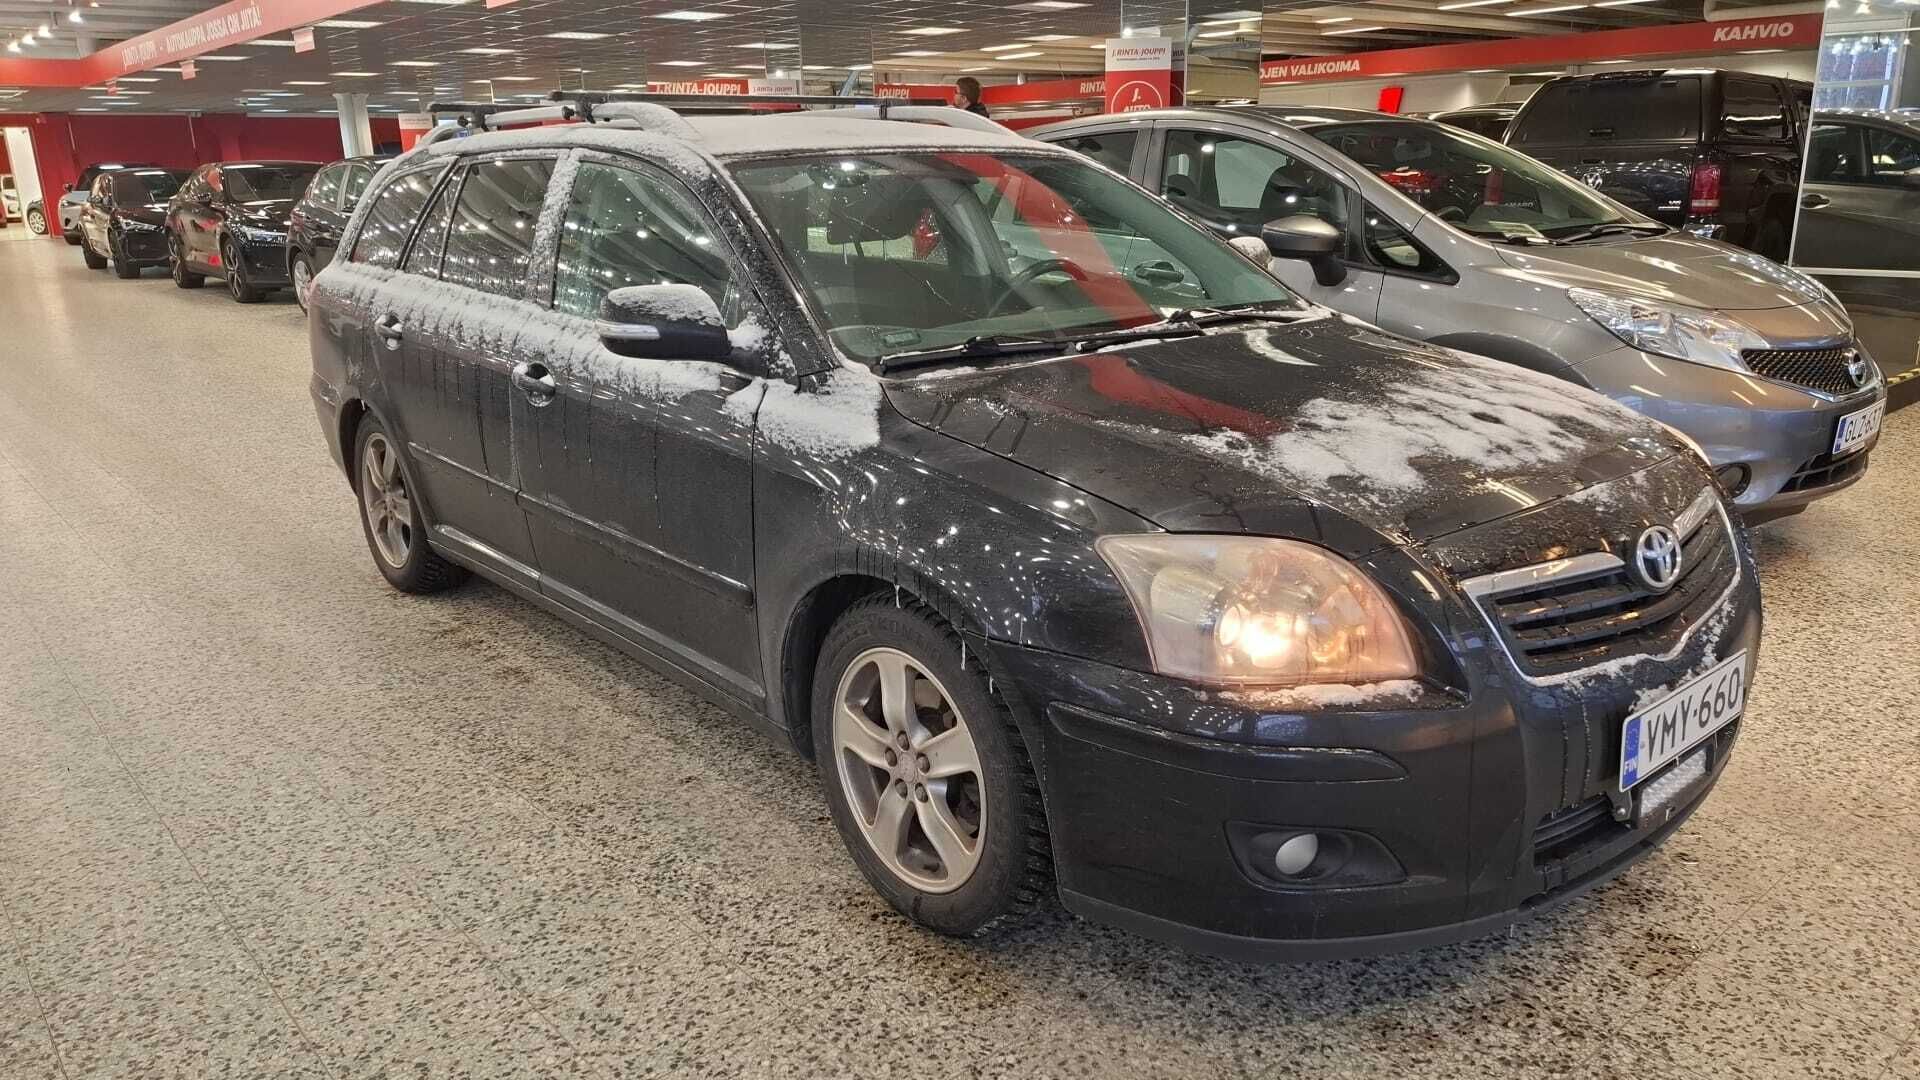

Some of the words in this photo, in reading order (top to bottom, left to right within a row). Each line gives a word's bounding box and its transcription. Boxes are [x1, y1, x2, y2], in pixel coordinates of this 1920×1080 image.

[227, 13, 242, 35] ON
[1713, 22, 1794, 42] KAHVIO
[1290, 59, 1361, 77] VALIKOIMA
[1648, 667, 1741, 762] VMY-660
